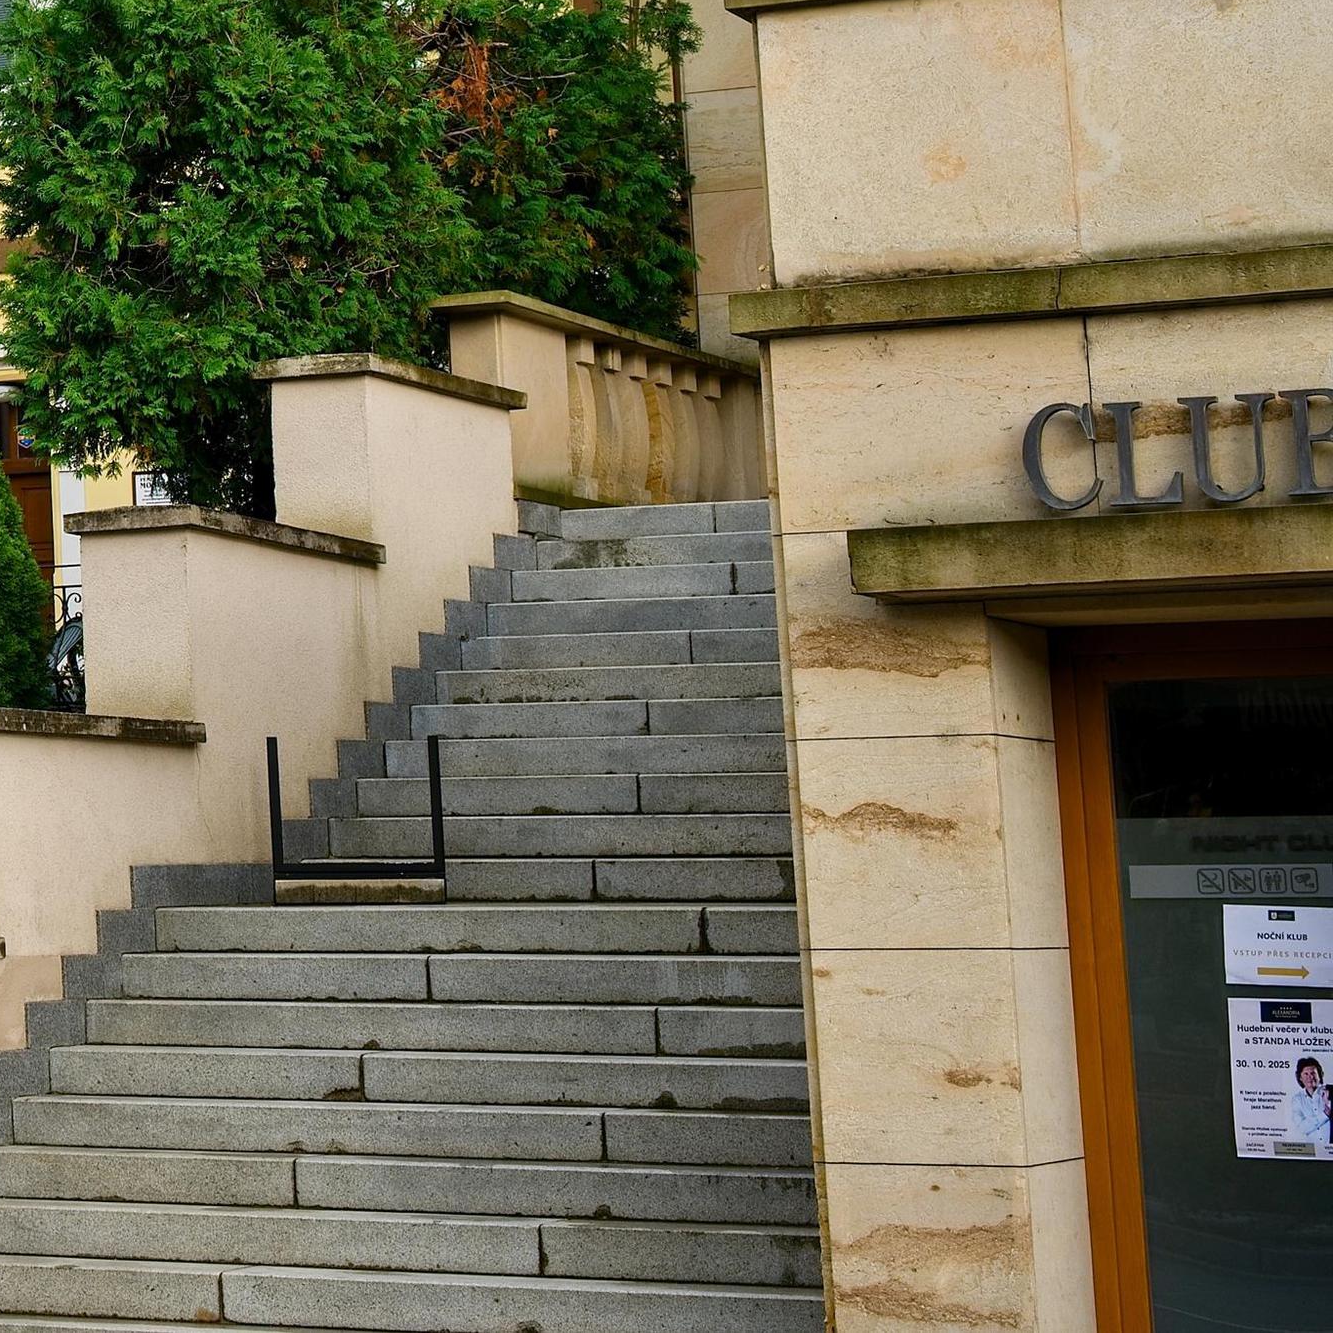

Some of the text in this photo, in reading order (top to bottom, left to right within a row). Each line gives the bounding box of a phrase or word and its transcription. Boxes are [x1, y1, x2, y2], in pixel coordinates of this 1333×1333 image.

[1022, 388, 1333, 511] CLUB
[1257, 931, 1308, 941] NOČNÍ KLUB
[1237, 1024, 1273, 1033] Hudební
[1276, 1024, 1300, 1033] večer
[1252, 1037, 1290, 1045] STANDA
[1293, 1036, 1331, 1047] HLOŽEK
[1236, 1059, 1290, 1069] 30. 10. 2025
